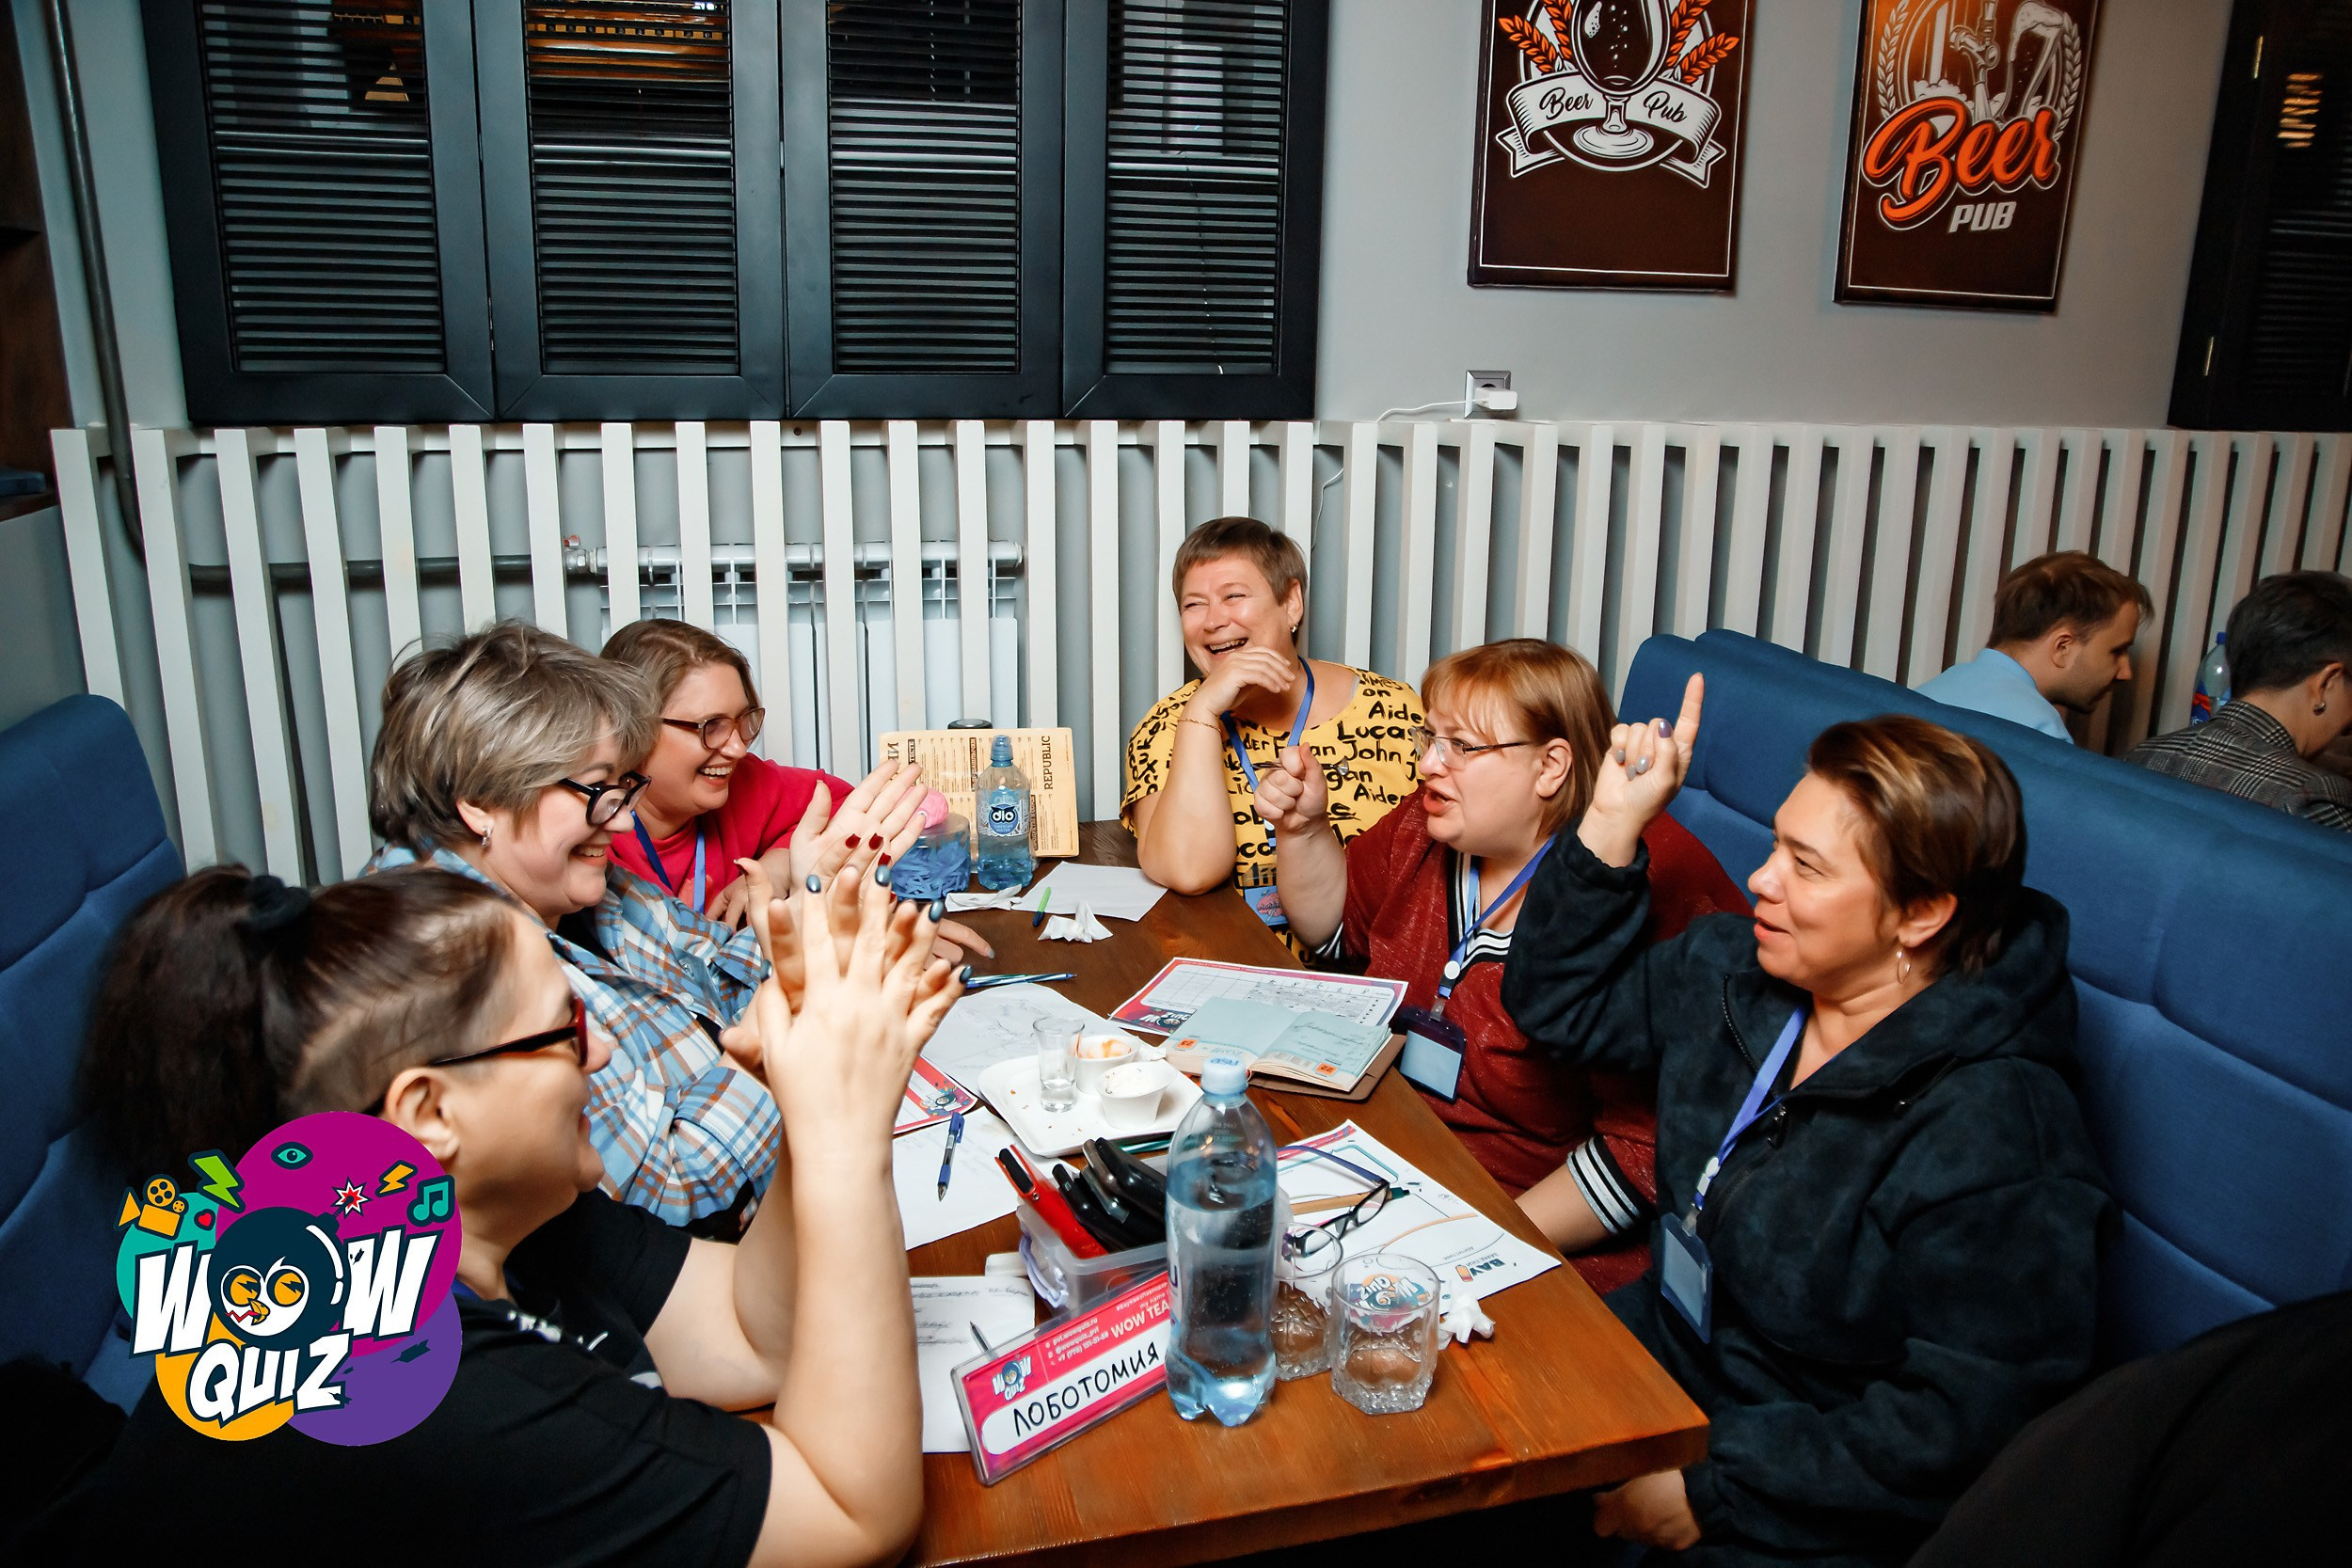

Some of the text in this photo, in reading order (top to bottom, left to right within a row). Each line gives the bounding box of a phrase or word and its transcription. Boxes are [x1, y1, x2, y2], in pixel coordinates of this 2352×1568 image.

[1539, 87, 1687, 123] Beer Pub
[1862, 97, 2060, 223] Beer
[1948, 201, 2016, 233] PUB
[1369, 701, 1423, 724] Aide
[1041, 736, 1054, 790] REPUBLIC
[1343, 739, 1402, 764] John
[1111, 1300, 1170, 1338] WOW TEA
[1004, 1377, 1026, 1402] QUIZ
[1013, 1341, 1159, 1437] ЛОБОТОМИЯ
